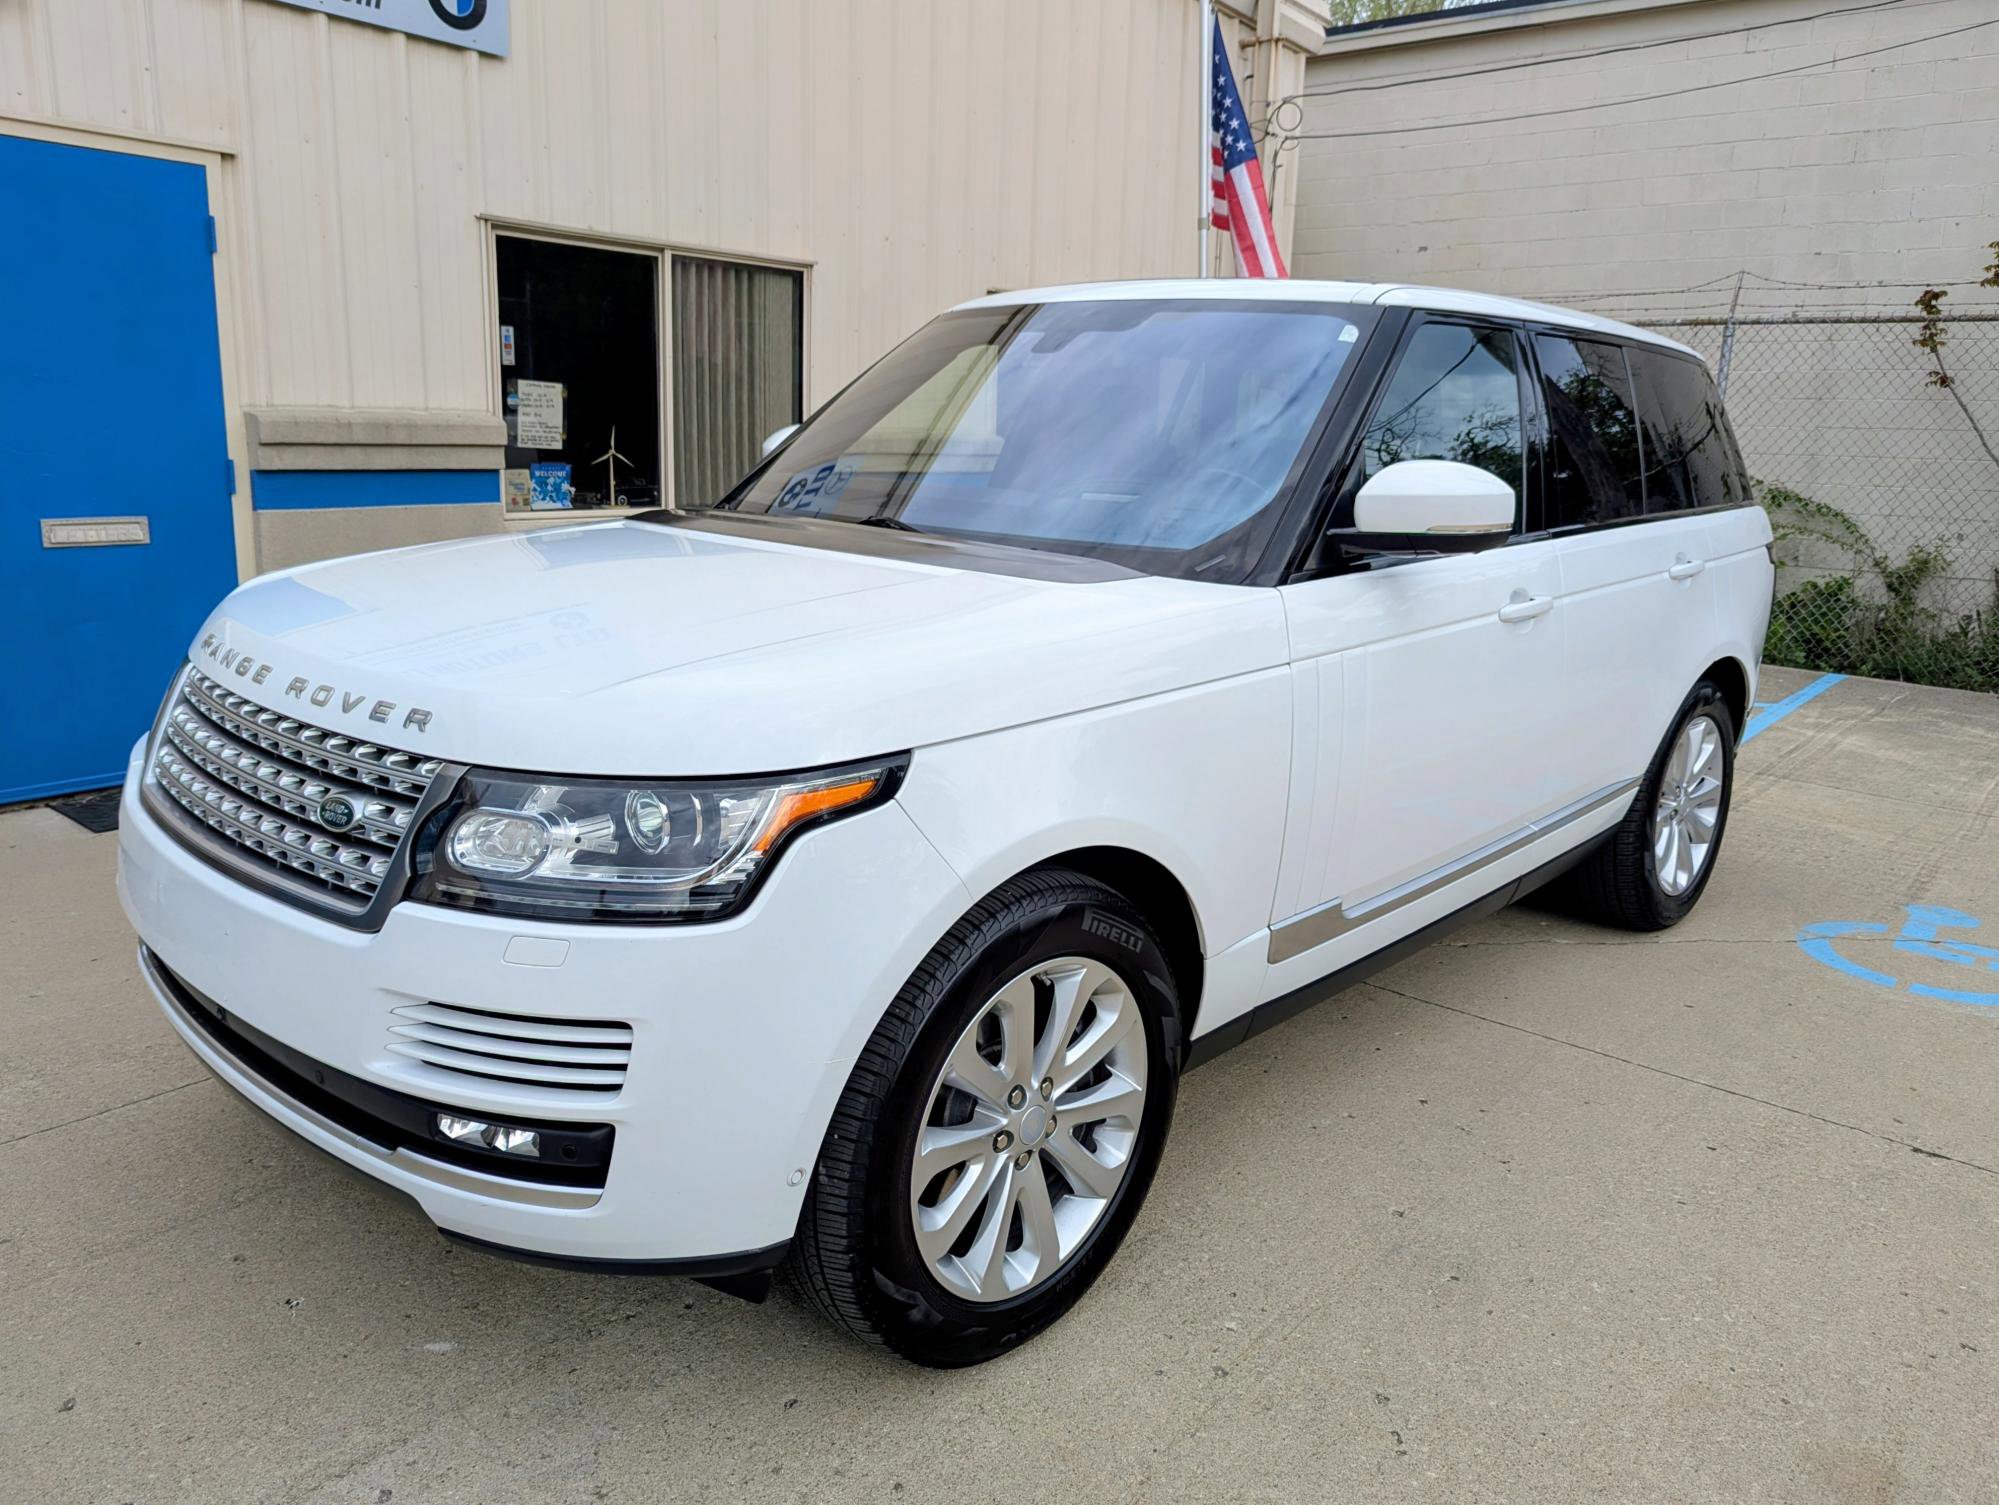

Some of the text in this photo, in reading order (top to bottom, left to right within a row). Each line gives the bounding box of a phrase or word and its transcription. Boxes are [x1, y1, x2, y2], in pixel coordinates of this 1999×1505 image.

[534, 470, 567, 478] WELCOME
[202, 633, 433, 733] RANGE ROVER
[324, 810, 348, 825] ROVER
[1081, 906, 1145, 953] PIRELLI
